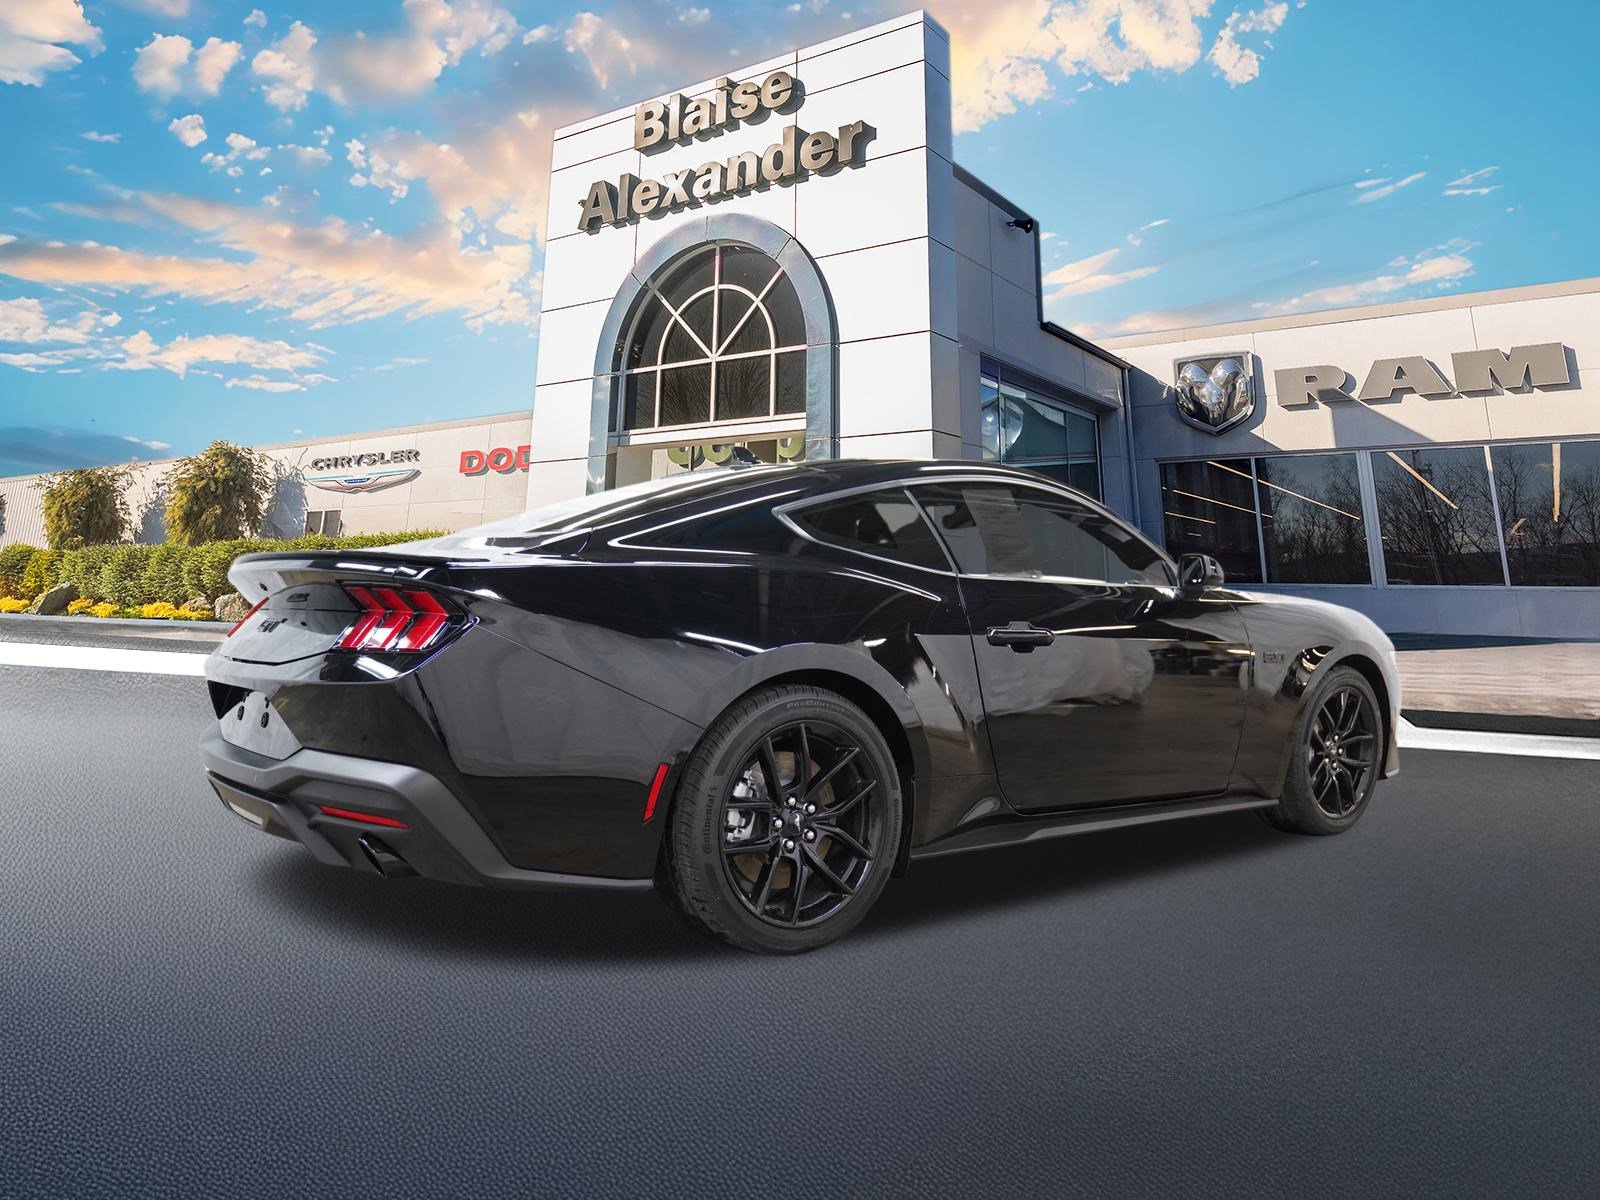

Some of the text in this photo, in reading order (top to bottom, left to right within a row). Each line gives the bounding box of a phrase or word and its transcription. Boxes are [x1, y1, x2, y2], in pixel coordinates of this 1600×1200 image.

[634, 71, 799, 153] Blaise
[577, 119, 870, 232] Alexander
[1274, 342, 1572, 408] RAM
[311, 448, 420, 471] CHRYSLER
